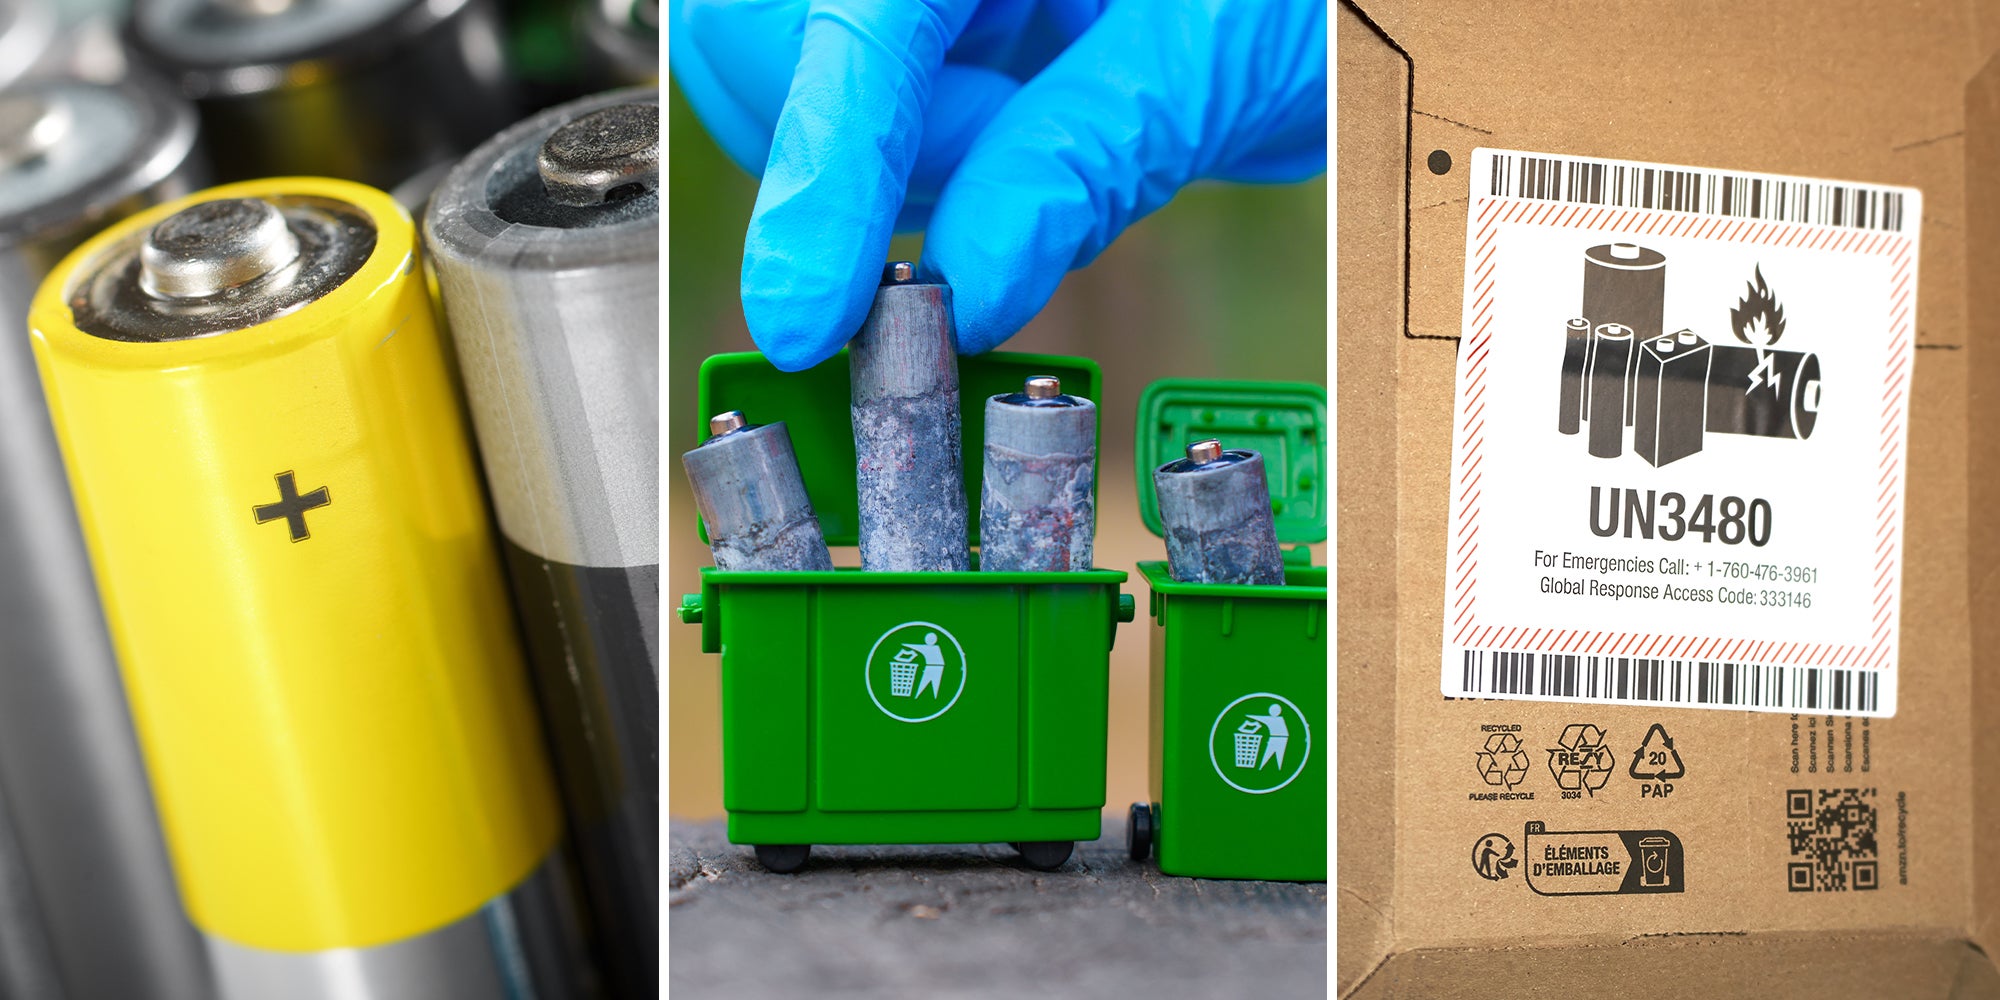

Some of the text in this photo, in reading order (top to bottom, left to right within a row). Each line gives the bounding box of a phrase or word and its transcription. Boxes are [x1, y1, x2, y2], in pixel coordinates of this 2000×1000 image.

[1589, 486, 1772, 547] UN3480
[1534, 550, 1559, 568] For
[1562, 551, 1655, 575] Emergencies
[1659, 557, 1690, 576] Call:
[1708, 560, 1818, 584] 1-760-476-3961
[1540, 576, 1812, 609] Global Response Access Code: 333146
[1481, 724, 1522, 732] RECYCLED
[1791, 723, 1799, 746] here
[1808, 717, 1817, 773] Scannez ici
[1826, 729, 1835, 773] Scannen
[1843, 721, 1852, 773] Scansiona
[1861, 729, 1870, 773] Escanea
[1648, 751, 1667, 766] 20
[1790, 748, 1799, 773] Scan
[1469, 791, 1535, 801] PLEASE RECYCLE
[1561, 791, 1582, 800] 3034
[1641, 783, 1674, 798] PAP
[1530, 823, 1541, 833] FR
[1897, 791, 1908, 885] amzn.to/recycle
[1544, 844, 1609, 860] ÉLÉMENTS
[1533, 861, 1620, 877] D'EMBALLAGE
